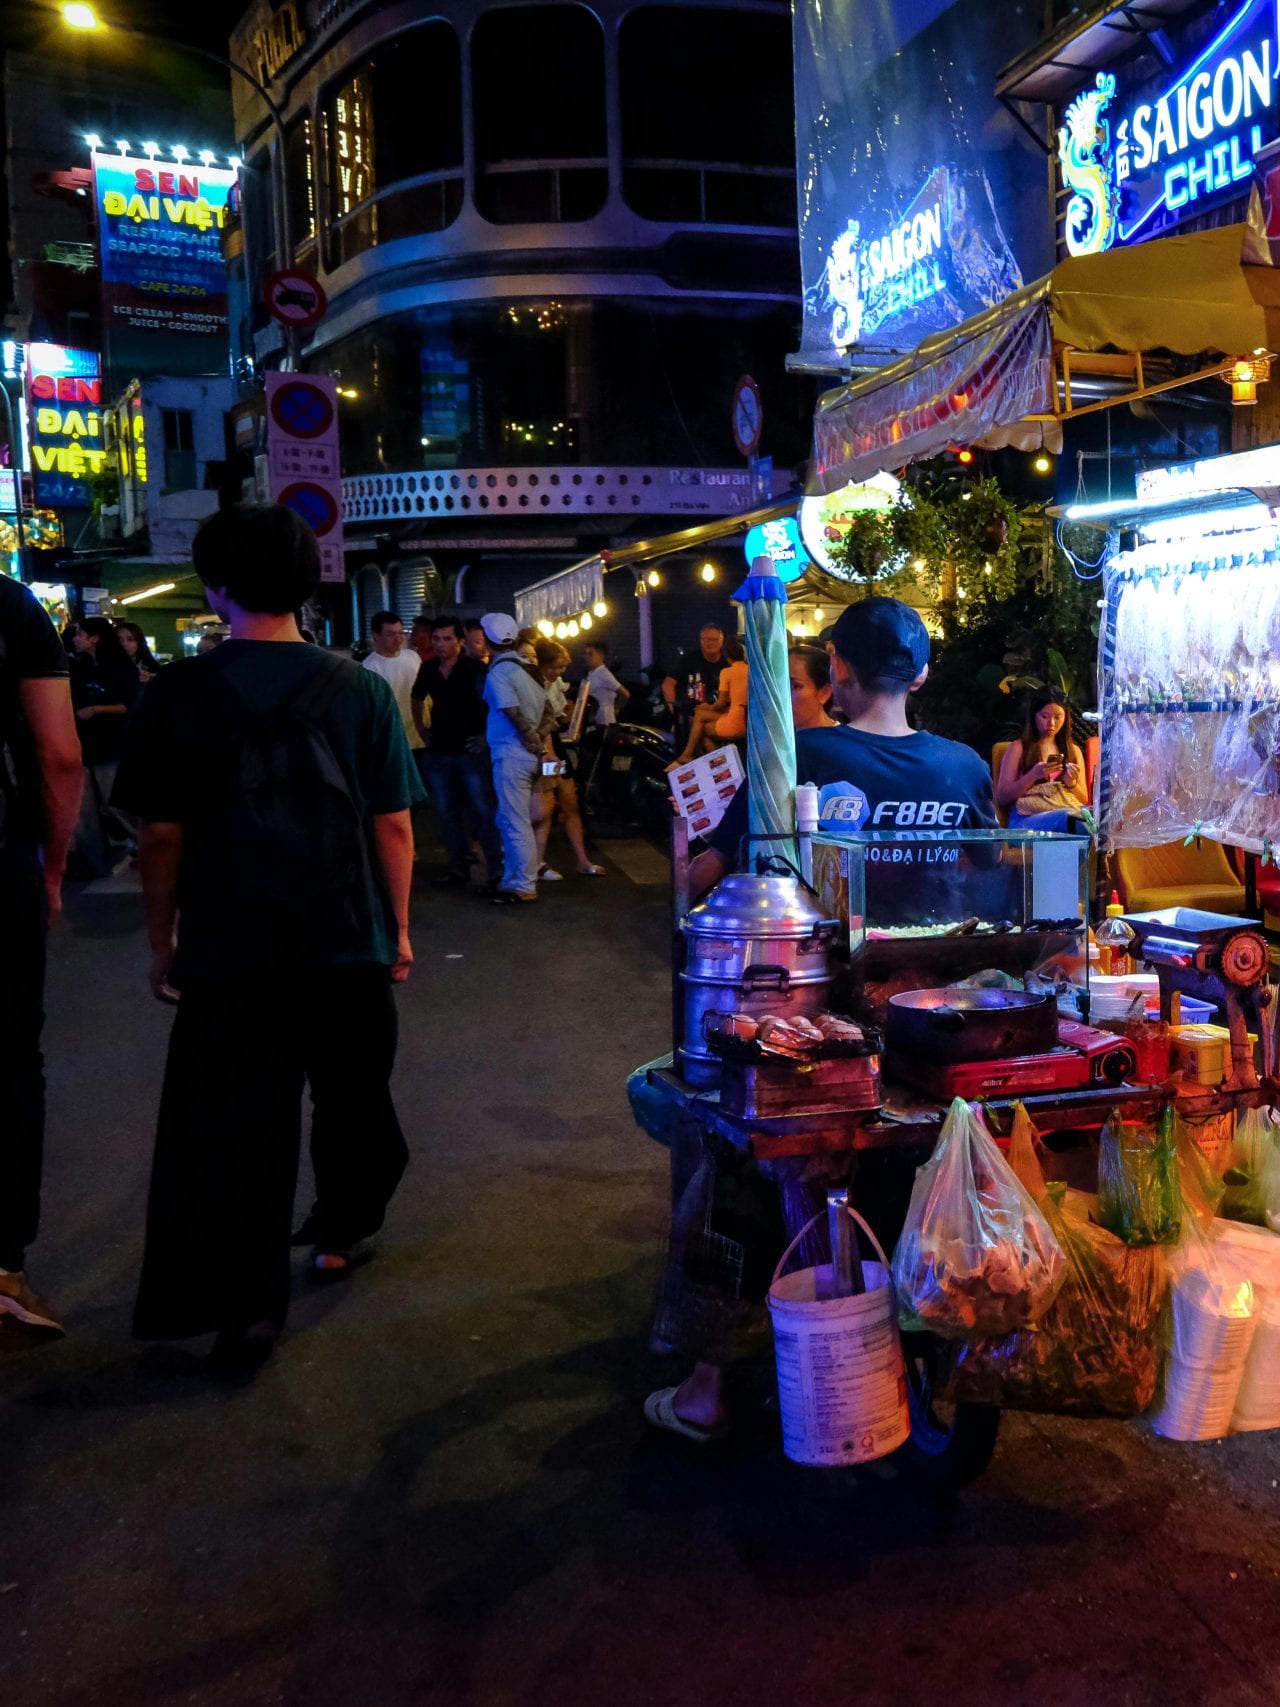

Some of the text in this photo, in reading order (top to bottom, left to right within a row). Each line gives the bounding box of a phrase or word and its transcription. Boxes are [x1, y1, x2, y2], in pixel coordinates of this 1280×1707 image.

[1132, 39, 1271, 169] SAIGON
[135, 168, 199, 197] SEN
[103, 191, 224, 231] ĐẠI VIỆT
[108, 239, 181, 257] SEAFOOD
[118, 224, 220, 247] RESTAURANT
[869, 202, 941, 287] SAIGON
[112, 305, 229, 325] ICE CREAM SMOOTH
[128, 317, 218, 333] JUICE COCONUT
[32, 375, 102, 404] SEN
[32, 442, 107, 478] VIỆT
[39, 483, 87, 498] 24/2
[670, 470, 751, 486] Restauran
[872, 801, 969, 828] F8BET
